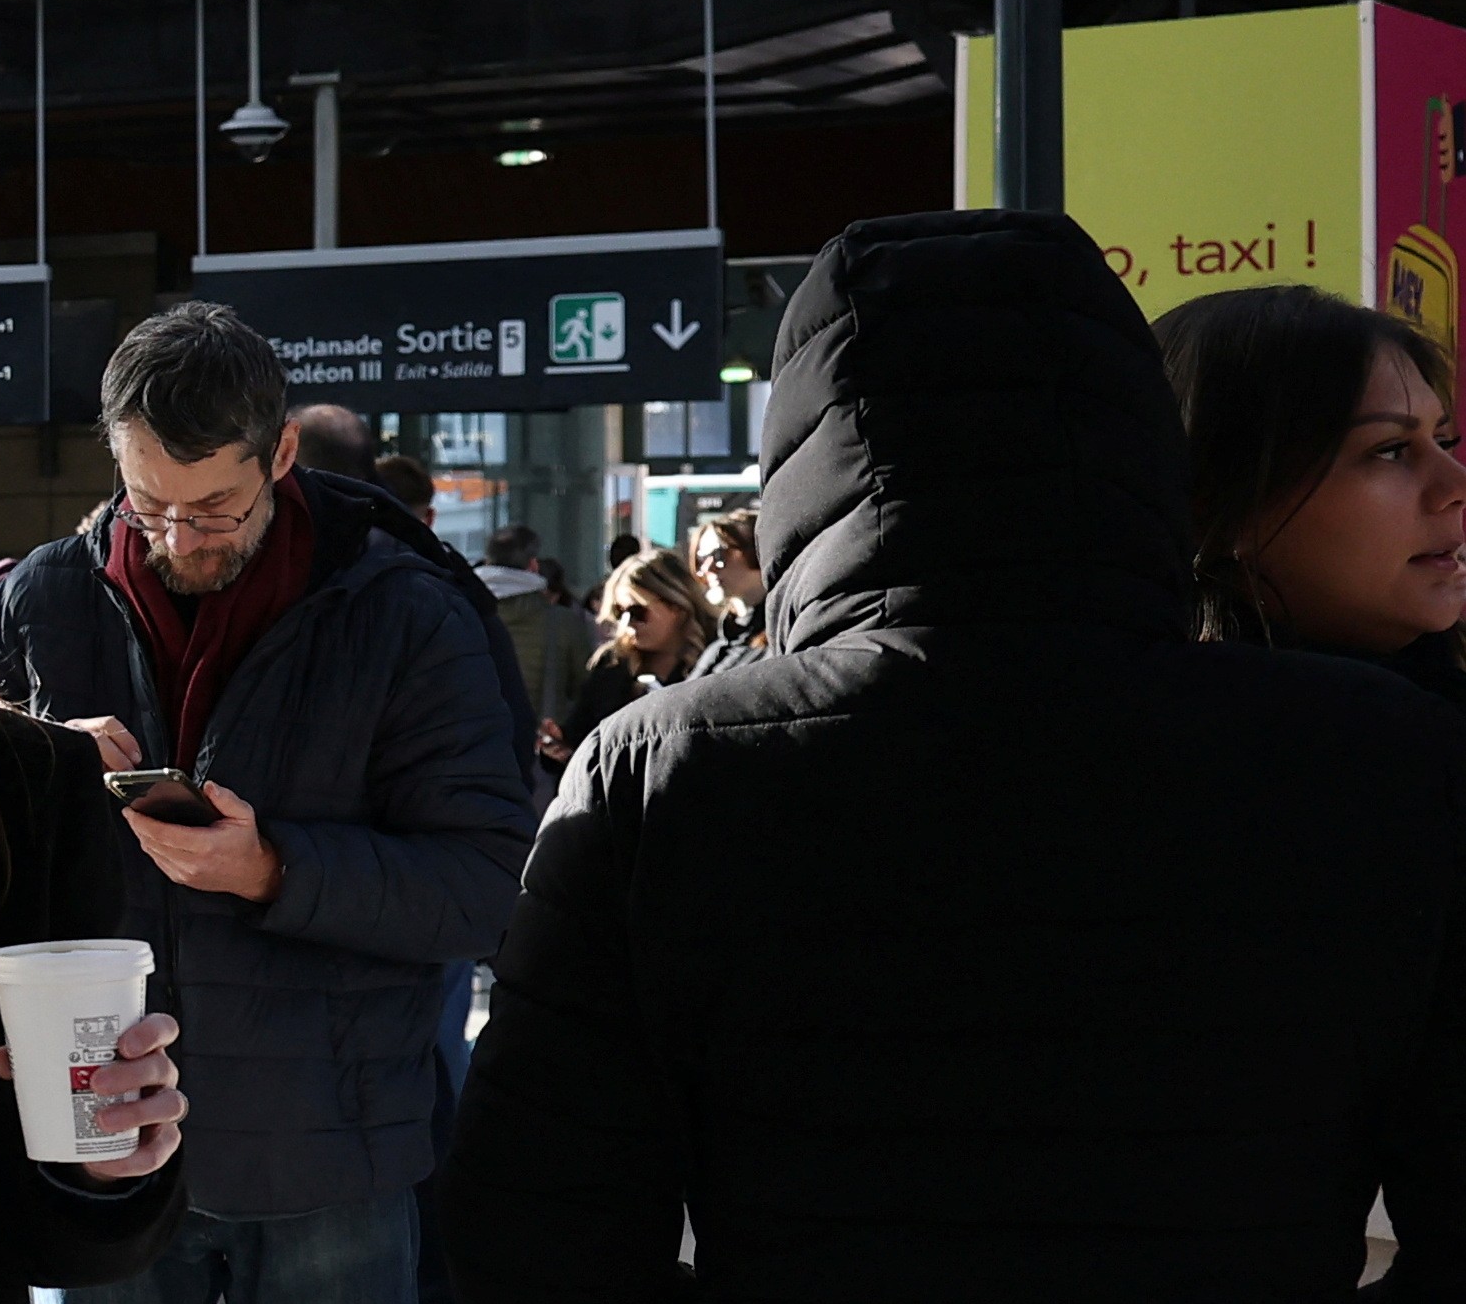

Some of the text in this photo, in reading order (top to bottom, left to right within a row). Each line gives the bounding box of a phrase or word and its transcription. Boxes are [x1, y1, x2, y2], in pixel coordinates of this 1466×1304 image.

[1170, 222, 1276, 276] taxi
[269, 334, 383, 362] Esplanade
[396, 321, 521, 354] Sortie 5
[359, 360, 383, 382] III
[394, 360, 494, 381] Exit Salida
